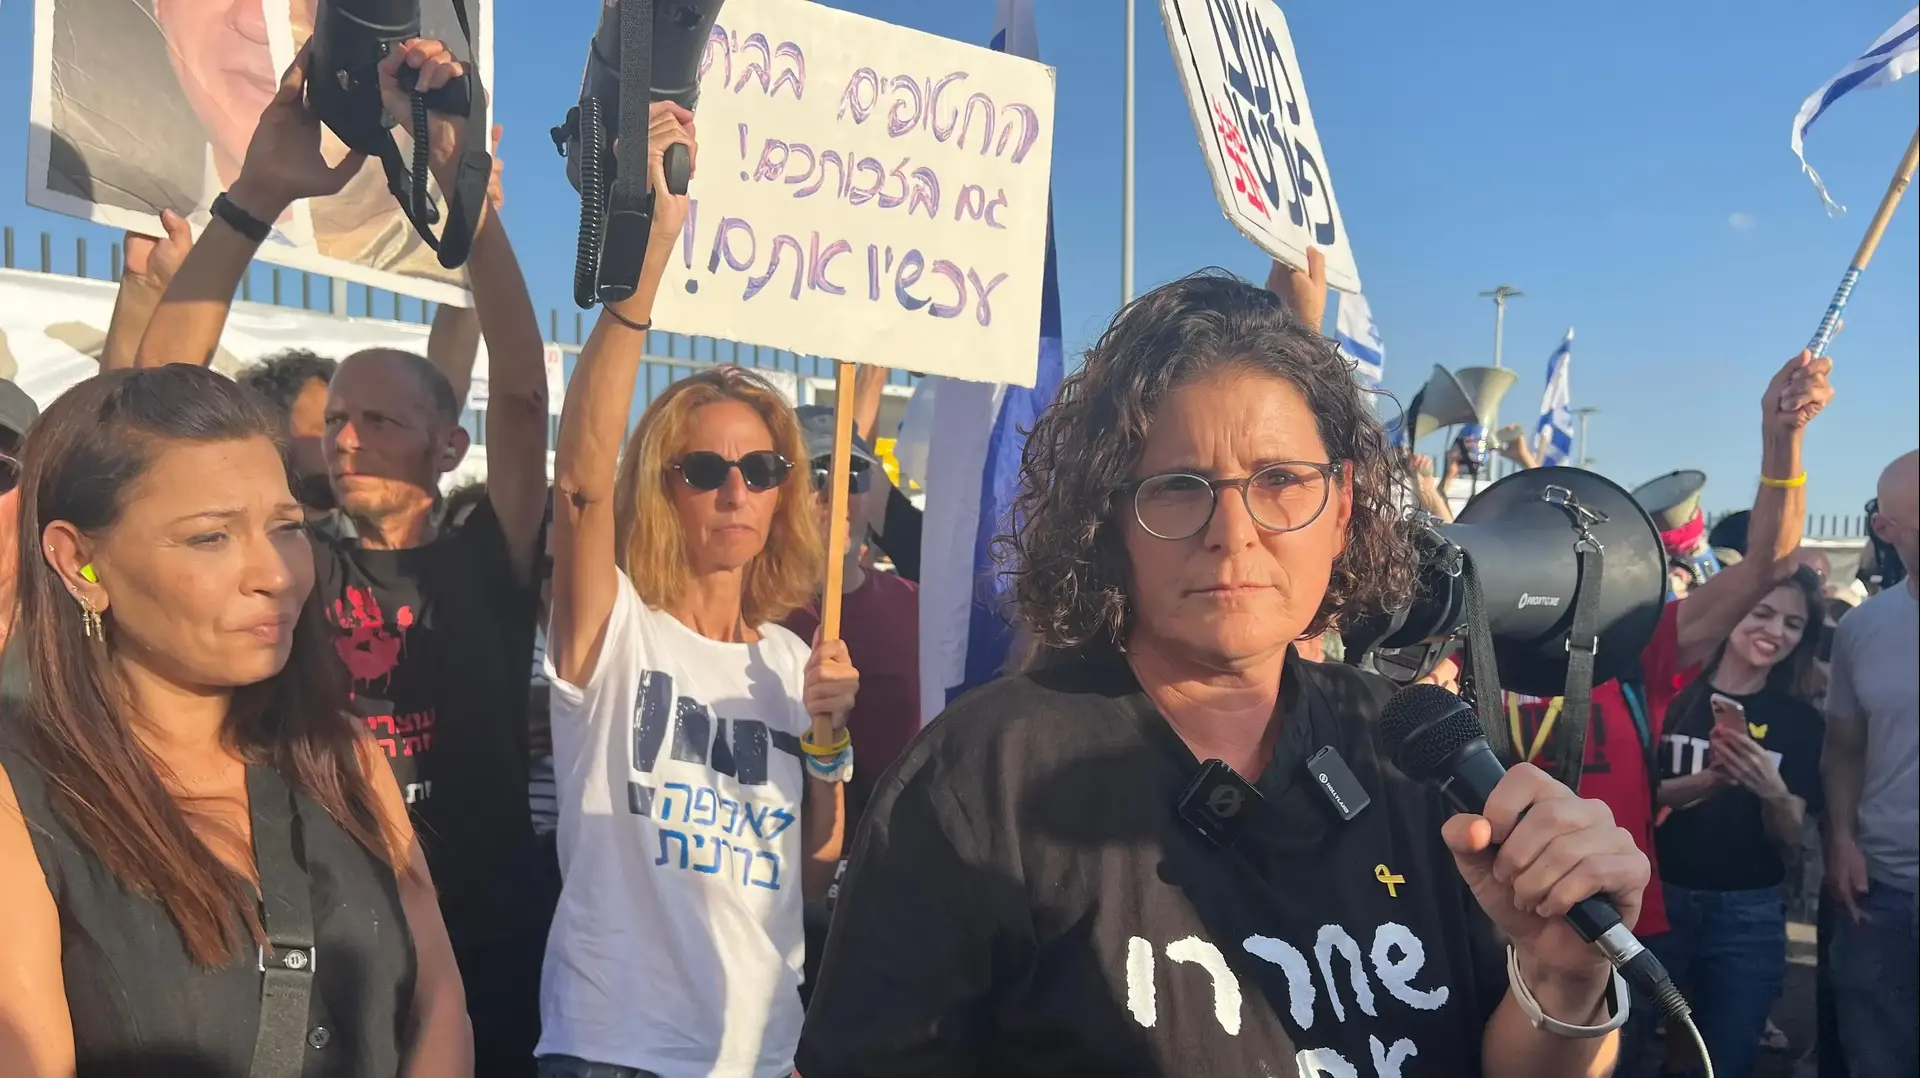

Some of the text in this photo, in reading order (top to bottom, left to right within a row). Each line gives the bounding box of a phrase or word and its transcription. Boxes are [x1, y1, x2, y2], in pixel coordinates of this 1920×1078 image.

[700, 24, 1040, 164] החטופים בבית
[954, 184, 1009, 229] גם
[867, 243, 1010, 328] עכשיו
[367, 707, 436, 735] עוצרי
[1325, 781, 1350, 814] HOLLYLAND
[1126, 921, 1450, 1036] שחררו
